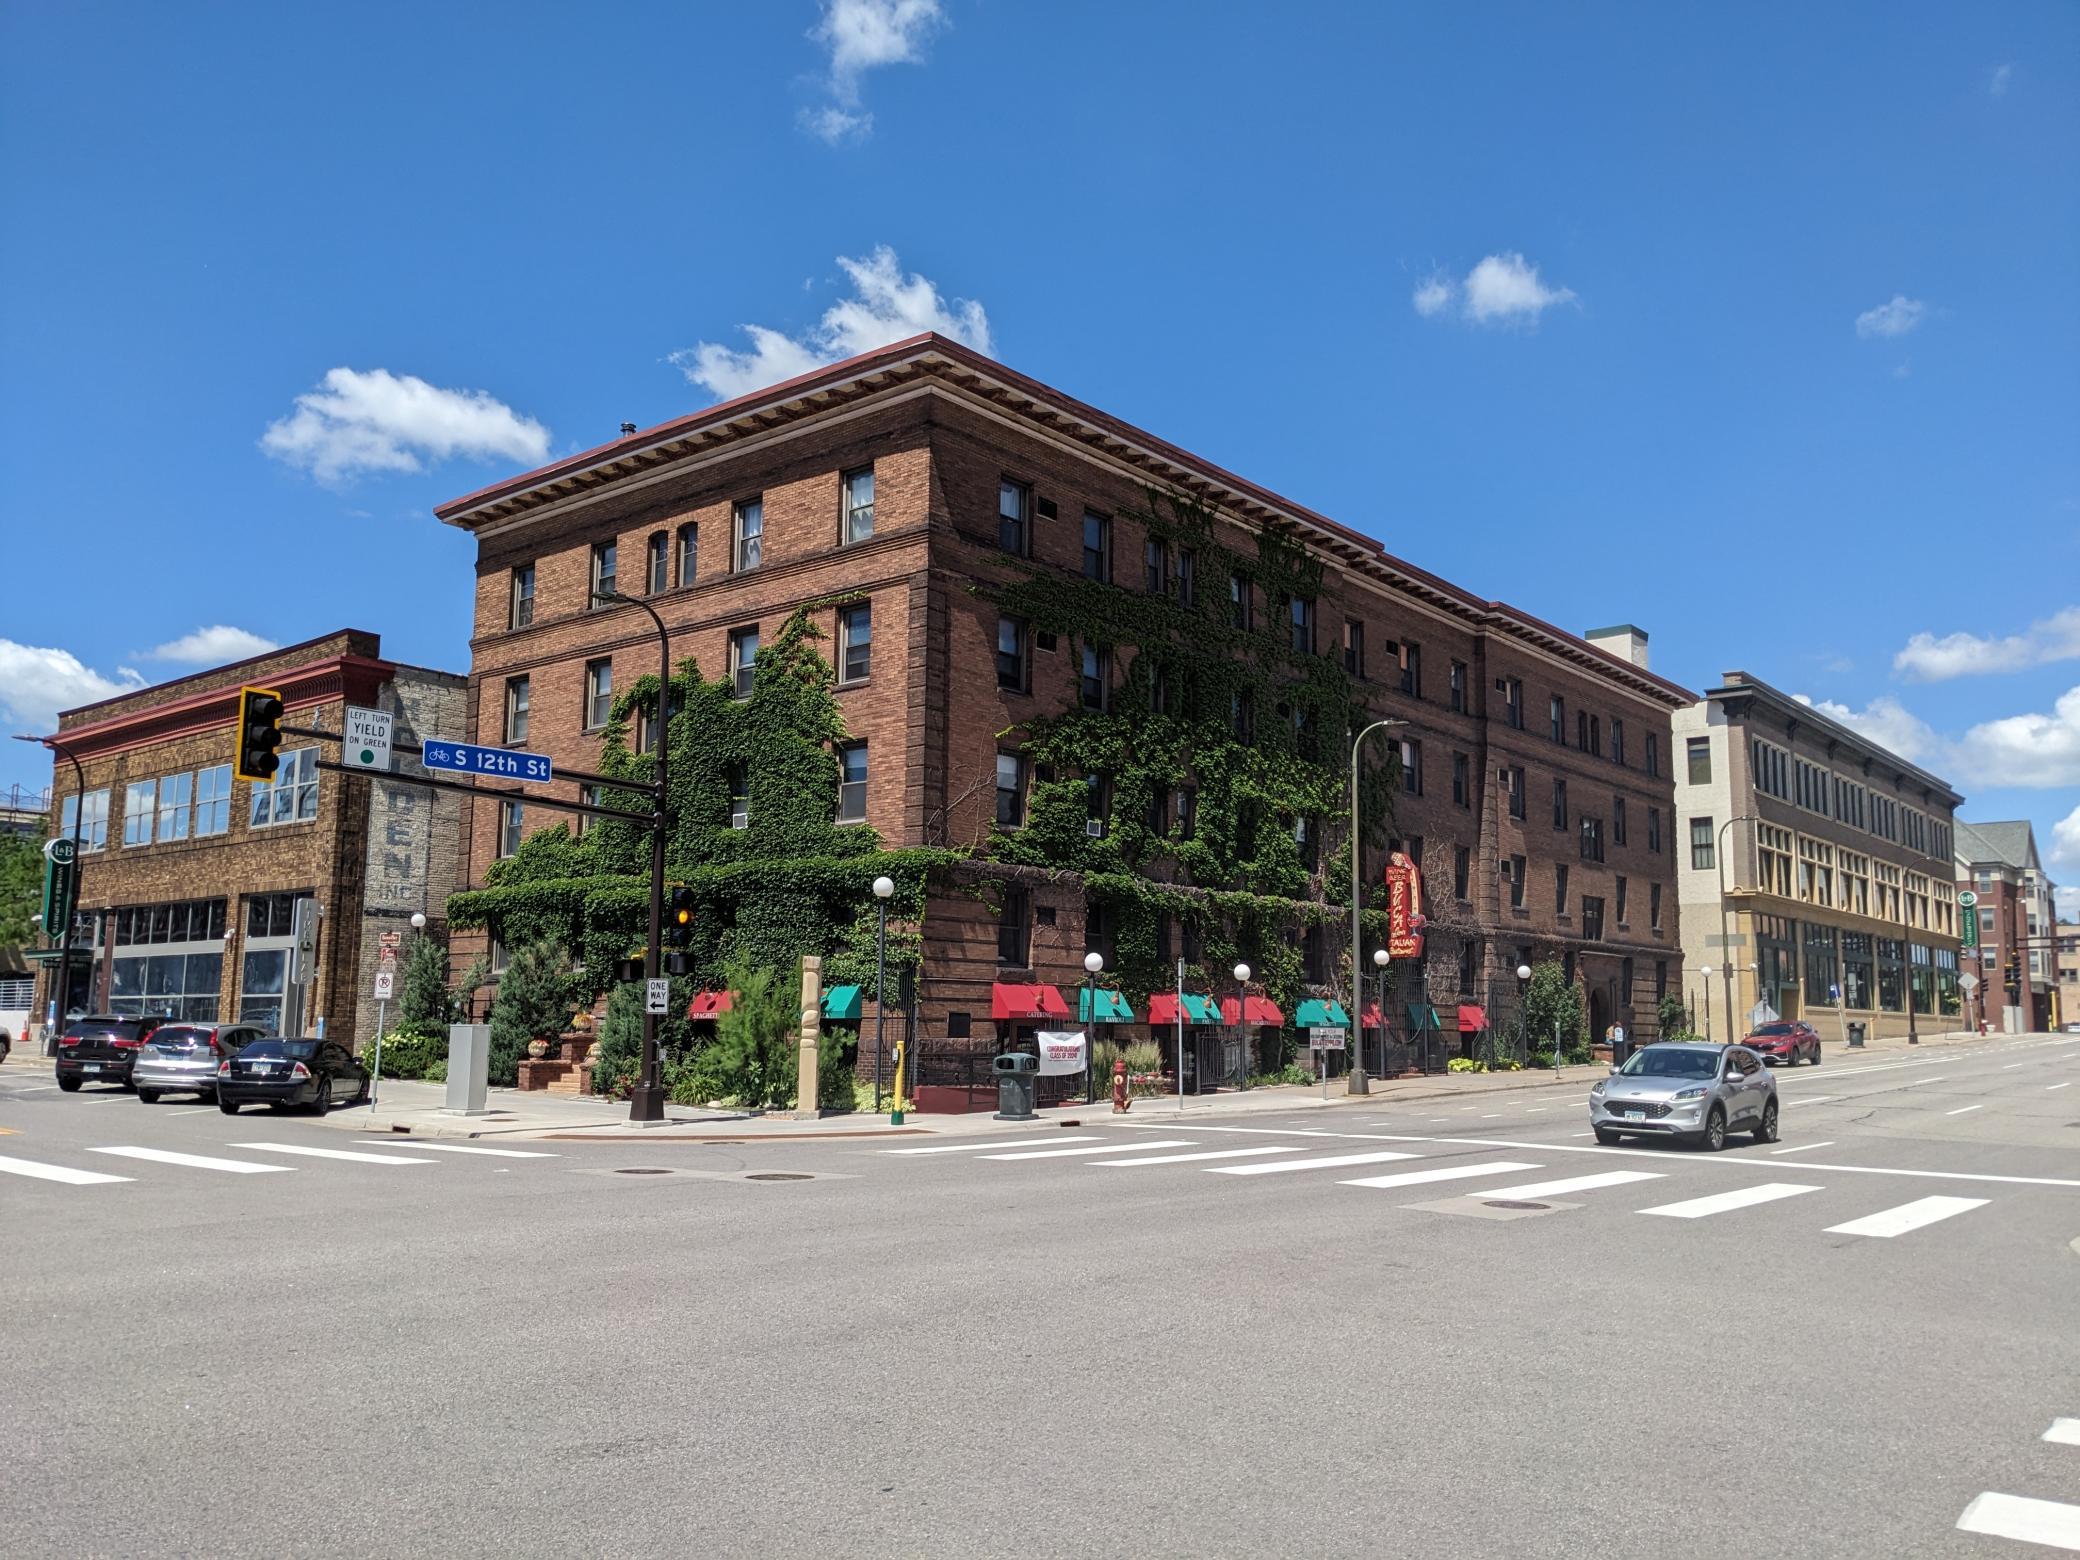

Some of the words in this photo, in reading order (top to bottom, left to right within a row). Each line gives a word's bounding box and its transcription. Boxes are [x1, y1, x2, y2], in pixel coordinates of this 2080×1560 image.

[350, 710, 367, 720] LEFT
[372, 714, 390, 724] TURN
[354, 722, 385, 737] YIELD
[349, 735, 359, 744] ON
[363, 737, 387, 749] GREEN
[454, 749, 467, 766] S
[477, 752, 518, 773] 12th
[527, 759, 547, 777] St
[1393, 881, 1404, 927] BUCA
[650, 982, 666, 991] ONE
[650, 991, 667, 1000] WAY
